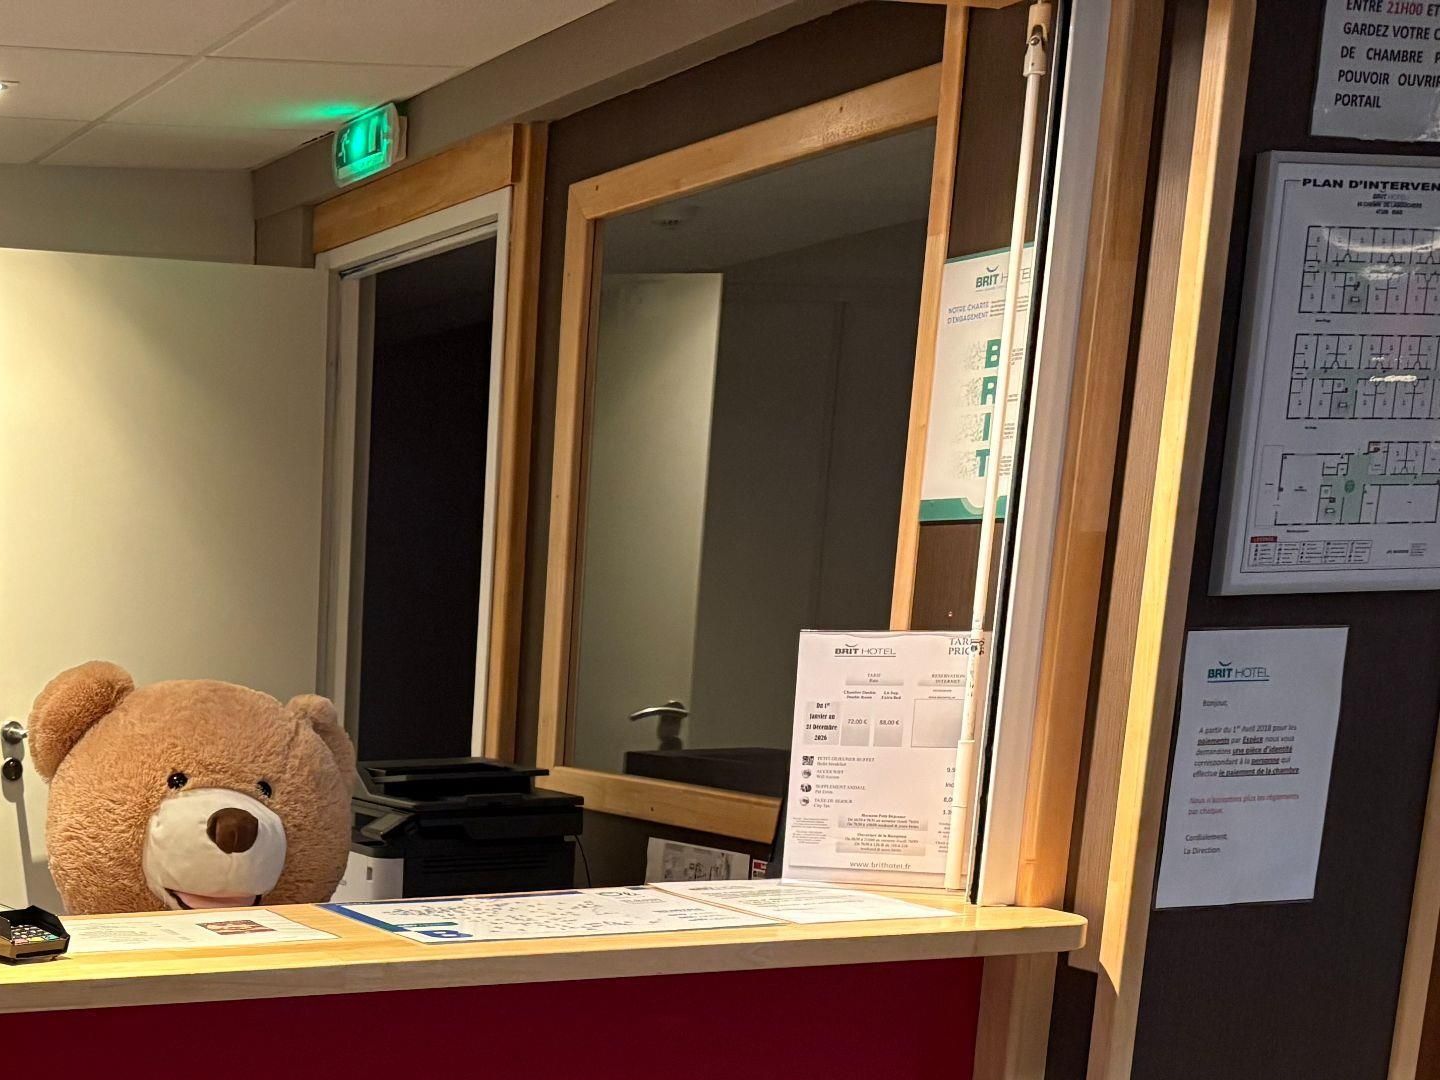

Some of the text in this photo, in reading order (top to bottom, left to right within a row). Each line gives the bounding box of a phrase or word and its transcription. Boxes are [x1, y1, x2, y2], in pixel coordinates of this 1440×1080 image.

[1346, 0, 1383, 13] ENTRE
[1387, 0, 1423, 15] 21H00
[1343, 22, 1389, 37] GARDEZ
[1393, 25, 1430, 40] VOTRE
[1340, 45, 1356, 59] DE
[1366, 47, 1423, 63] CHAMBRE
[1338, 69, 1389, 85] POUVOIR
[1334, 93, 1382, 108] PORTAIL
[1302, 178, 1440, 192] PLAN D'INTERVEN
[975, 273, 999, 288] BRIT
[861, 648, 897, 656] HOTEL
[1207, 667, 1270, 679] BRIT HOTEL
